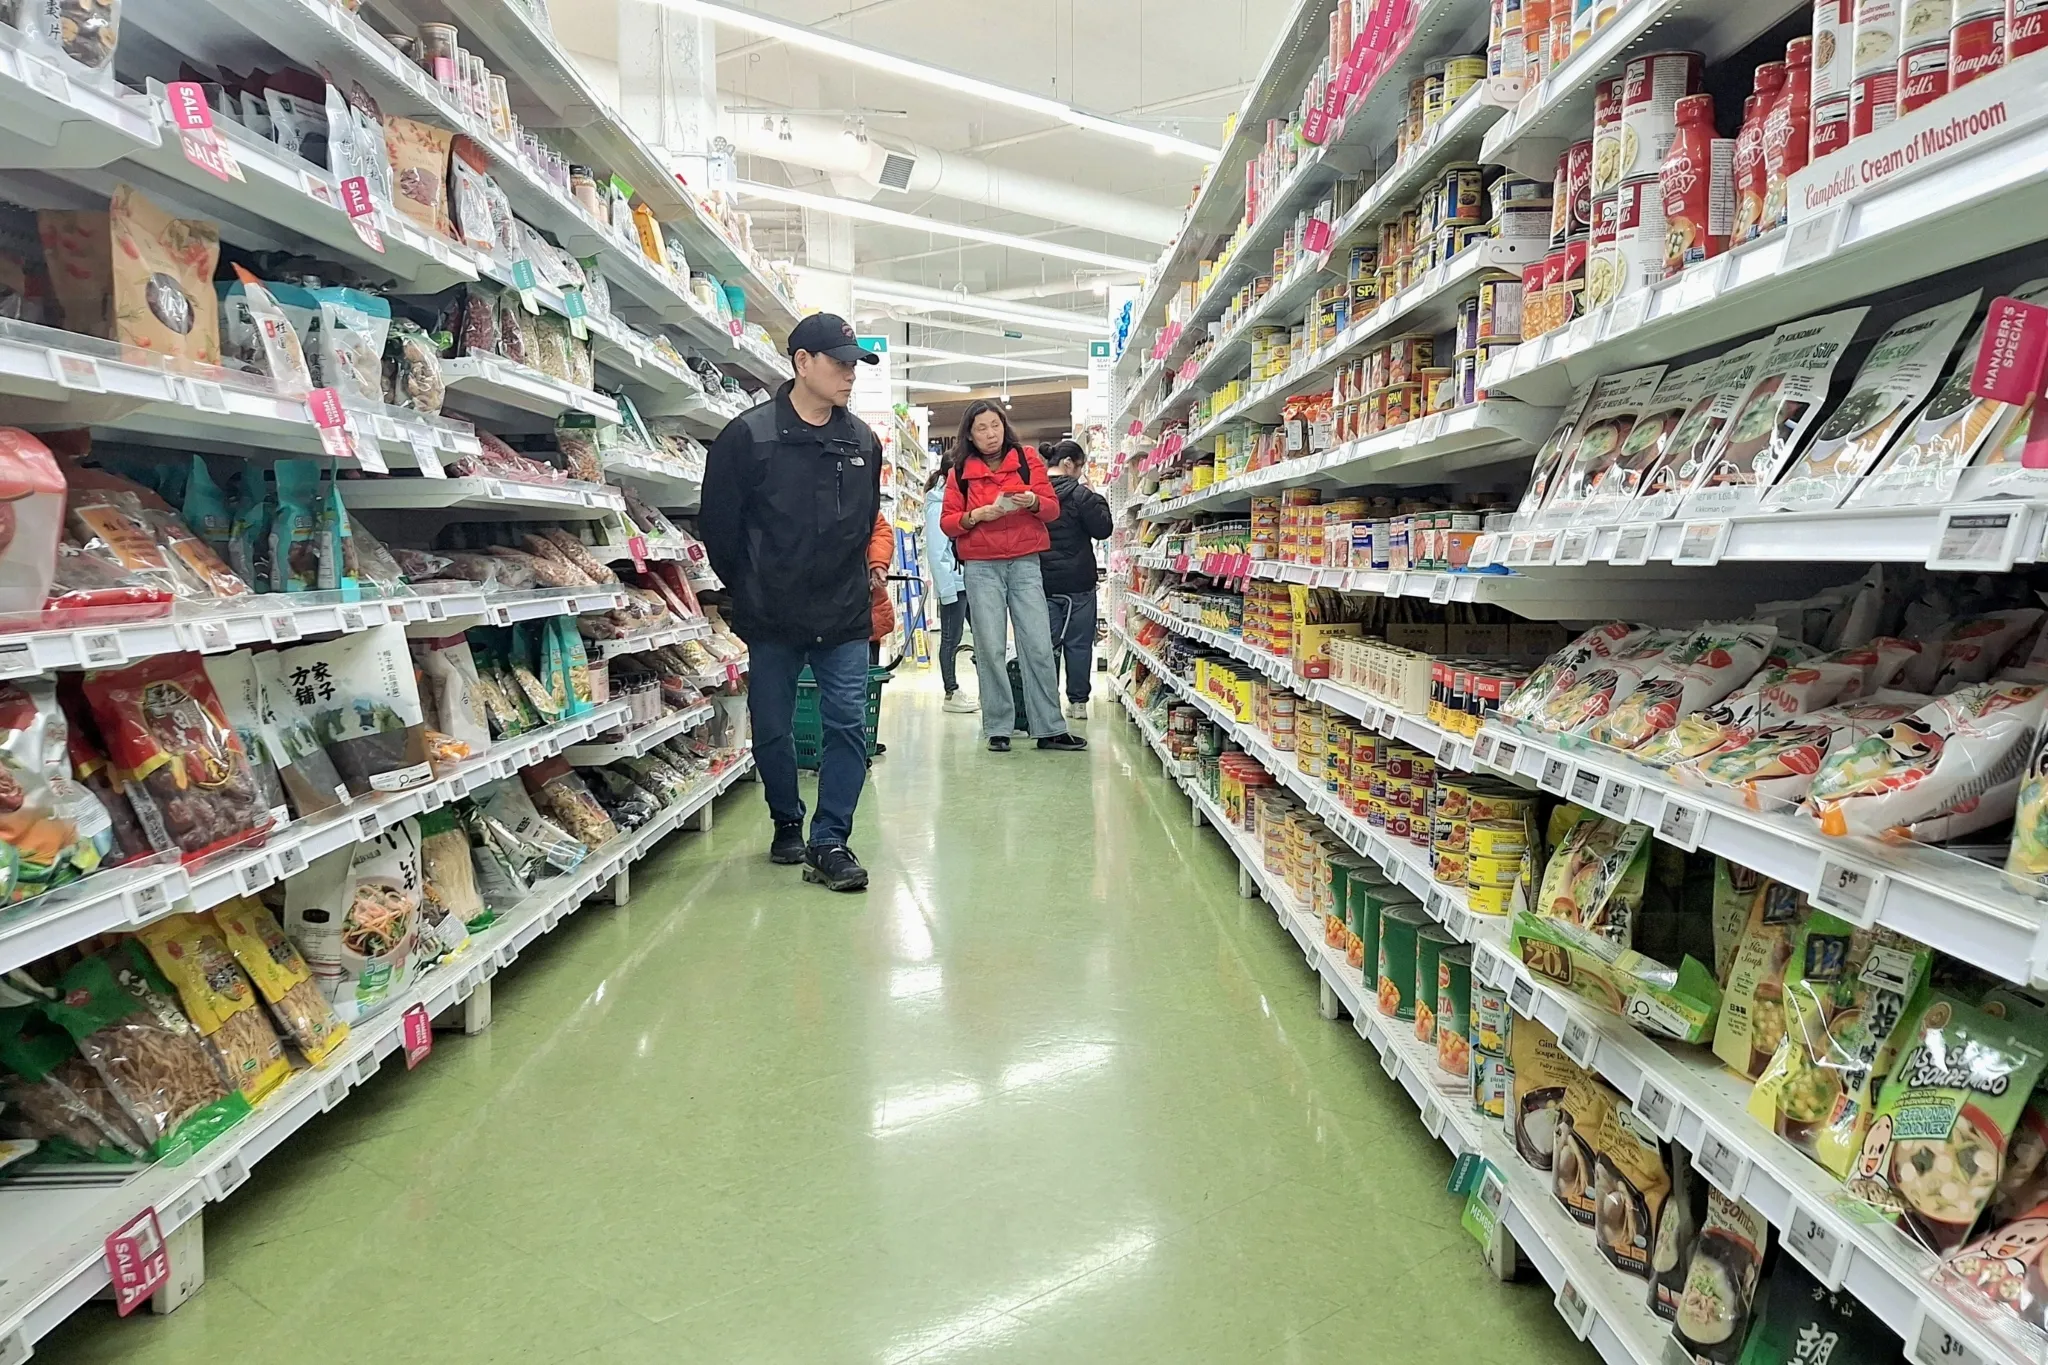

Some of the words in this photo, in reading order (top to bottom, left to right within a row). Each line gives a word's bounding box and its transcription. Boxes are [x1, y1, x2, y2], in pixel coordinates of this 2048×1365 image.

[180, 86, 203, 126] SALE
[1326, 86, 1338, 115] SALE
[1308, 112, 1322, 138] SALE
[1570, 148, 1589, 172] Tim
[1803, 165, 1859, 211] Campbell's
[1861, 147, 1903, 184] Cream
[1905, 133, 1920, 163] of
[1922, 101, 2007, 157] Mushroom
[349, 180, 367, 213] SALE
[873, 341, 882, 351] A
[1097, 346, 1105, 355] B
[1983, 305, 2016, 391] MANAGER'S
[2001, 309, 2028, 368] SPECIAL
[289, 661, 333, 687] 方家
[1526, 944, 1562, 976] 20
[1740, 952, 1763, 970] Soup
[1454, 1154, 1472, 1193] MEMBER
[115, 1242, 137, 1284] SALE
